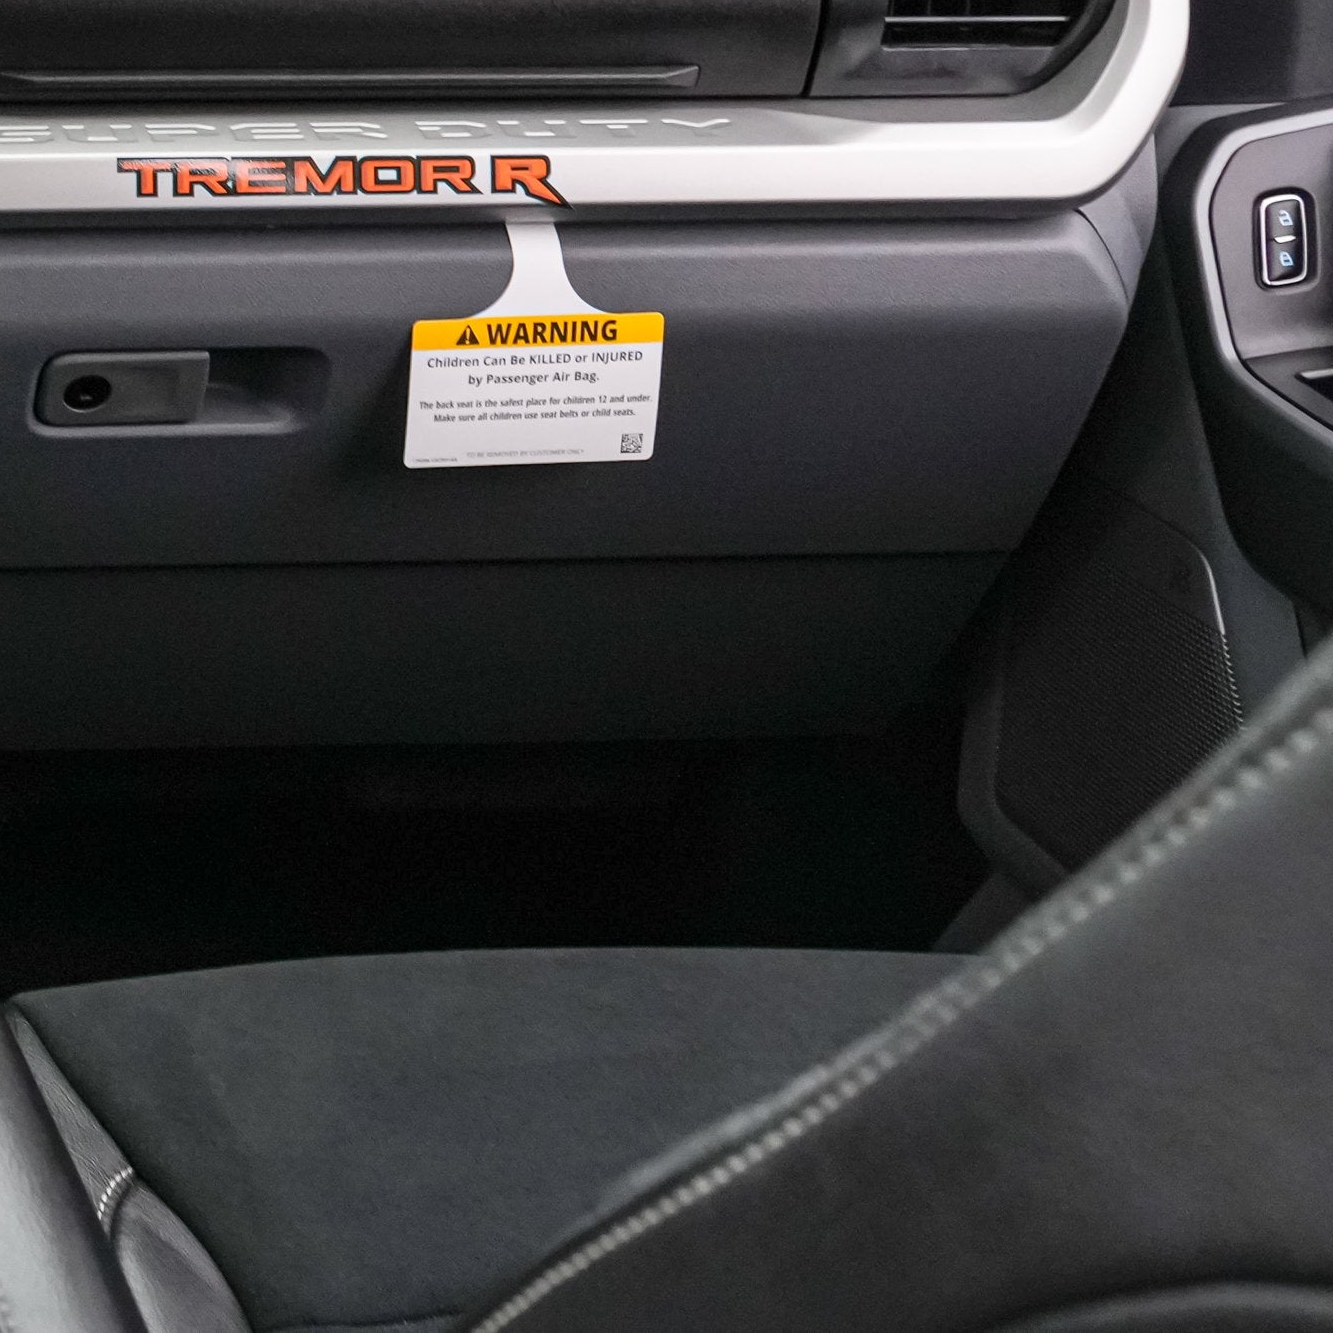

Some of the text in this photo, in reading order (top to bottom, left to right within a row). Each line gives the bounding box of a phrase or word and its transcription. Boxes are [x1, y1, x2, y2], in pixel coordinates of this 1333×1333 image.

[415, 118, 731, 142] DUTY
[117, 154, 574, 210] TREMOR R
[486, 320, 618, 345] WARNING
[427, 351, 643, 368] Children Can Be KILLED or INJURED
[468, 370, 600, 386] by Passenger Air Bag.
[419, 394, 652, 410] The back seat is the safest place for children 12 and under.
[433, 414, 456, 422] Make
[458, 414, 475, 422] sure
[477, 412, 488, 421] all
[489, 411, 523, 421] children
[540, 411, 557, 419] seat
[559, 409, 579, 418] belts
[592, 408, 611, 416] child
[613, 408, 636, 416] seats.
